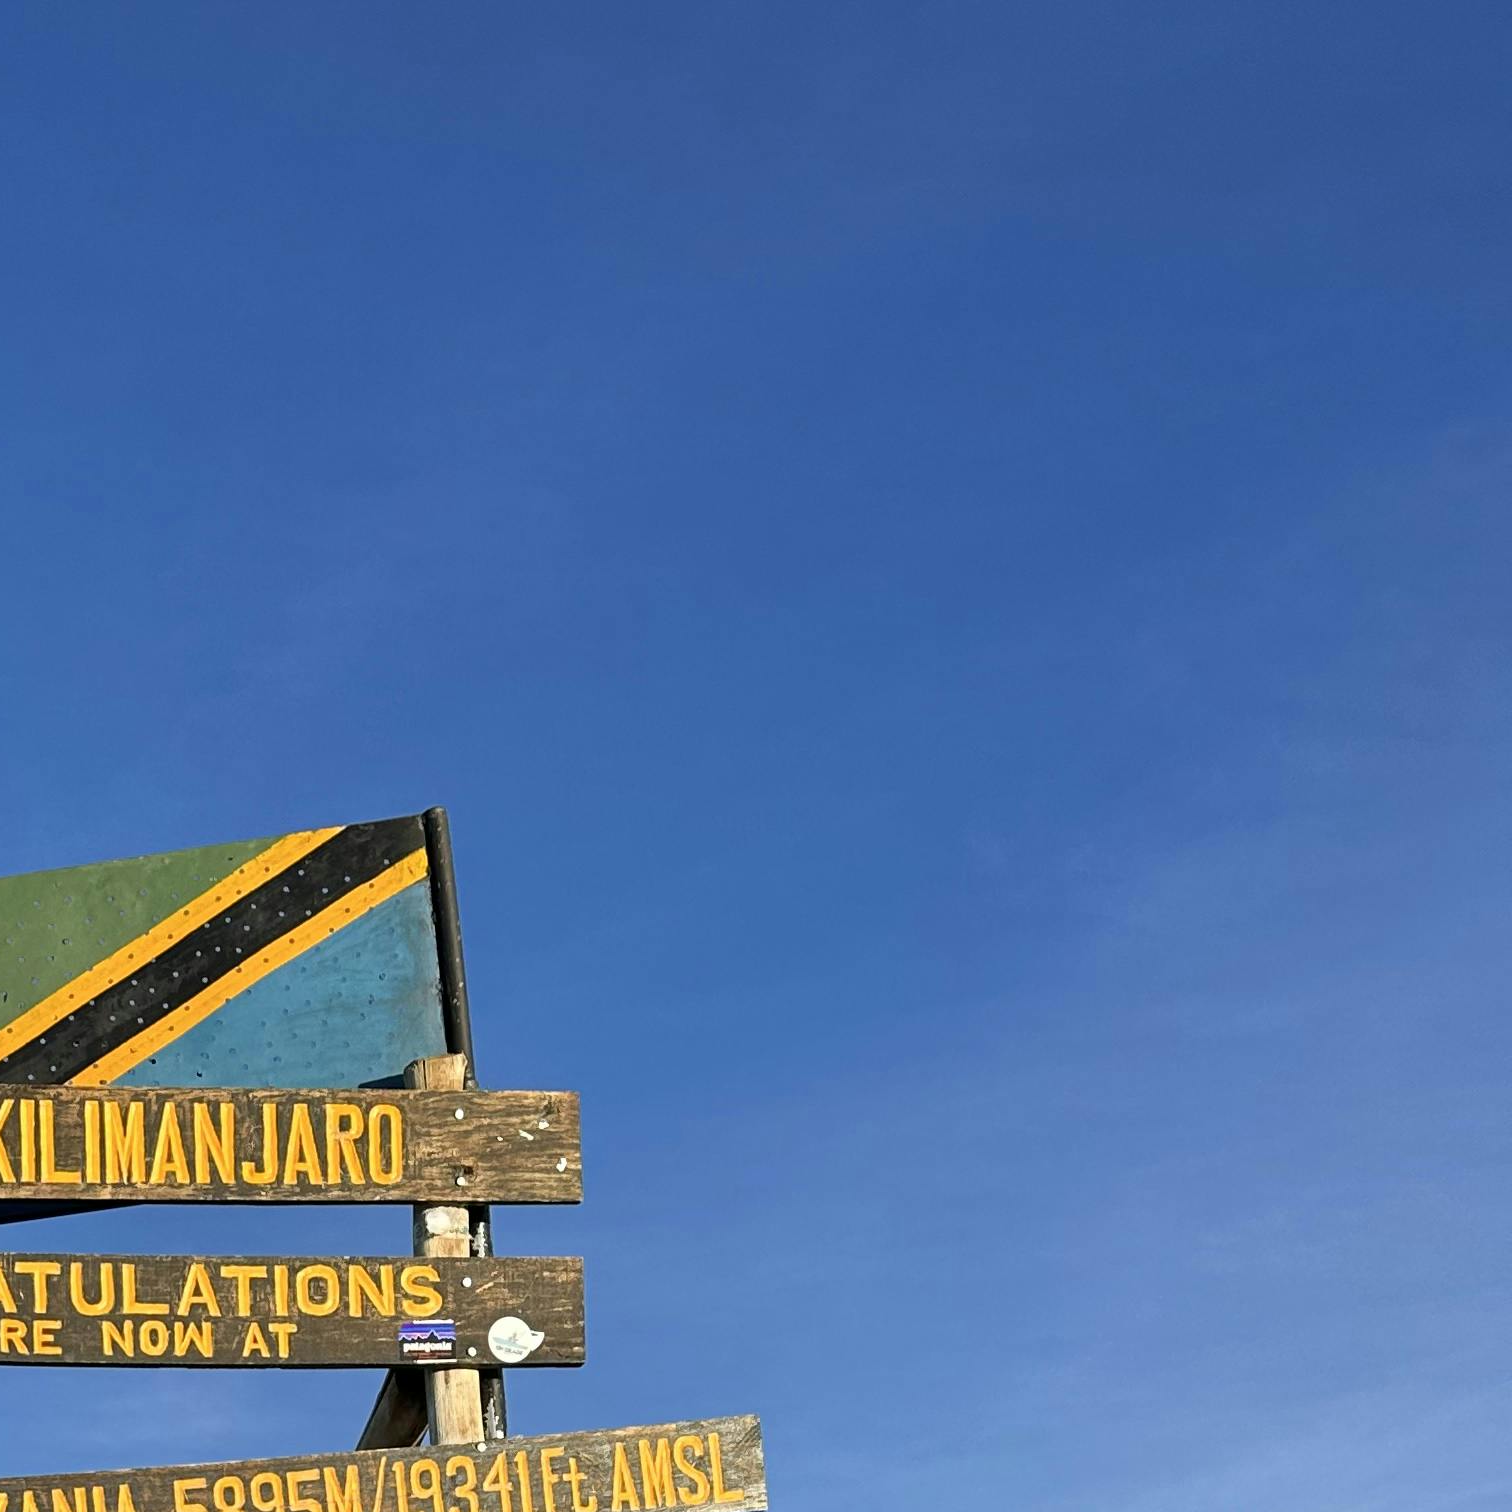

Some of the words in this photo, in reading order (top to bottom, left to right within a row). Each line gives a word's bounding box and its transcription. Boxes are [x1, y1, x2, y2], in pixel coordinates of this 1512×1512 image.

[101, 1320, 214, 1357] NOW
[242, 1321, 297, 1357] AT
[610, 1433, 746, 1512] AMSL
